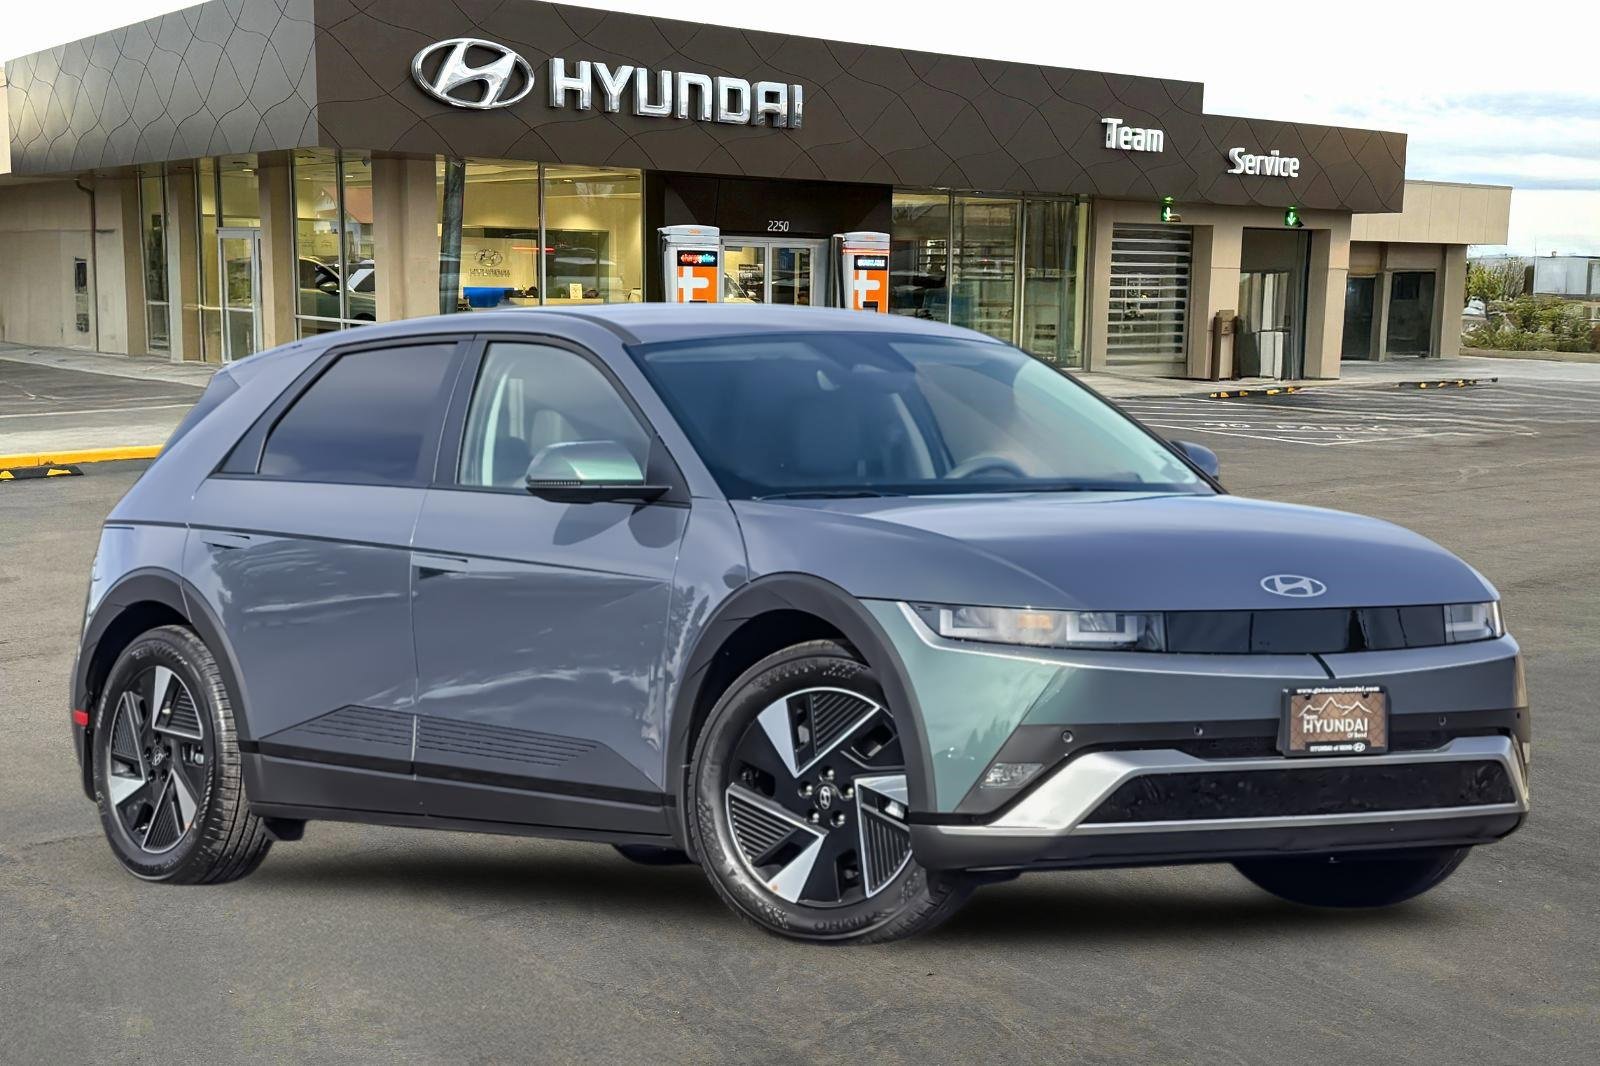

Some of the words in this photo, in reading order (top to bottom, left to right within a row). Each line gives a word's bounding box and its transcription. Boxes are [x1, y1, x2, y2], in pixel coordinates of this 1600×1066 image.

[549, 57, 803, 129] HYUNDAI
[1101, 117, 1164, 152] Team
[1227, 147, 1300, 178] Service
[767, 220, 790, 232] 2250
[1303, 718, 1368, 733] HYUNDAI
